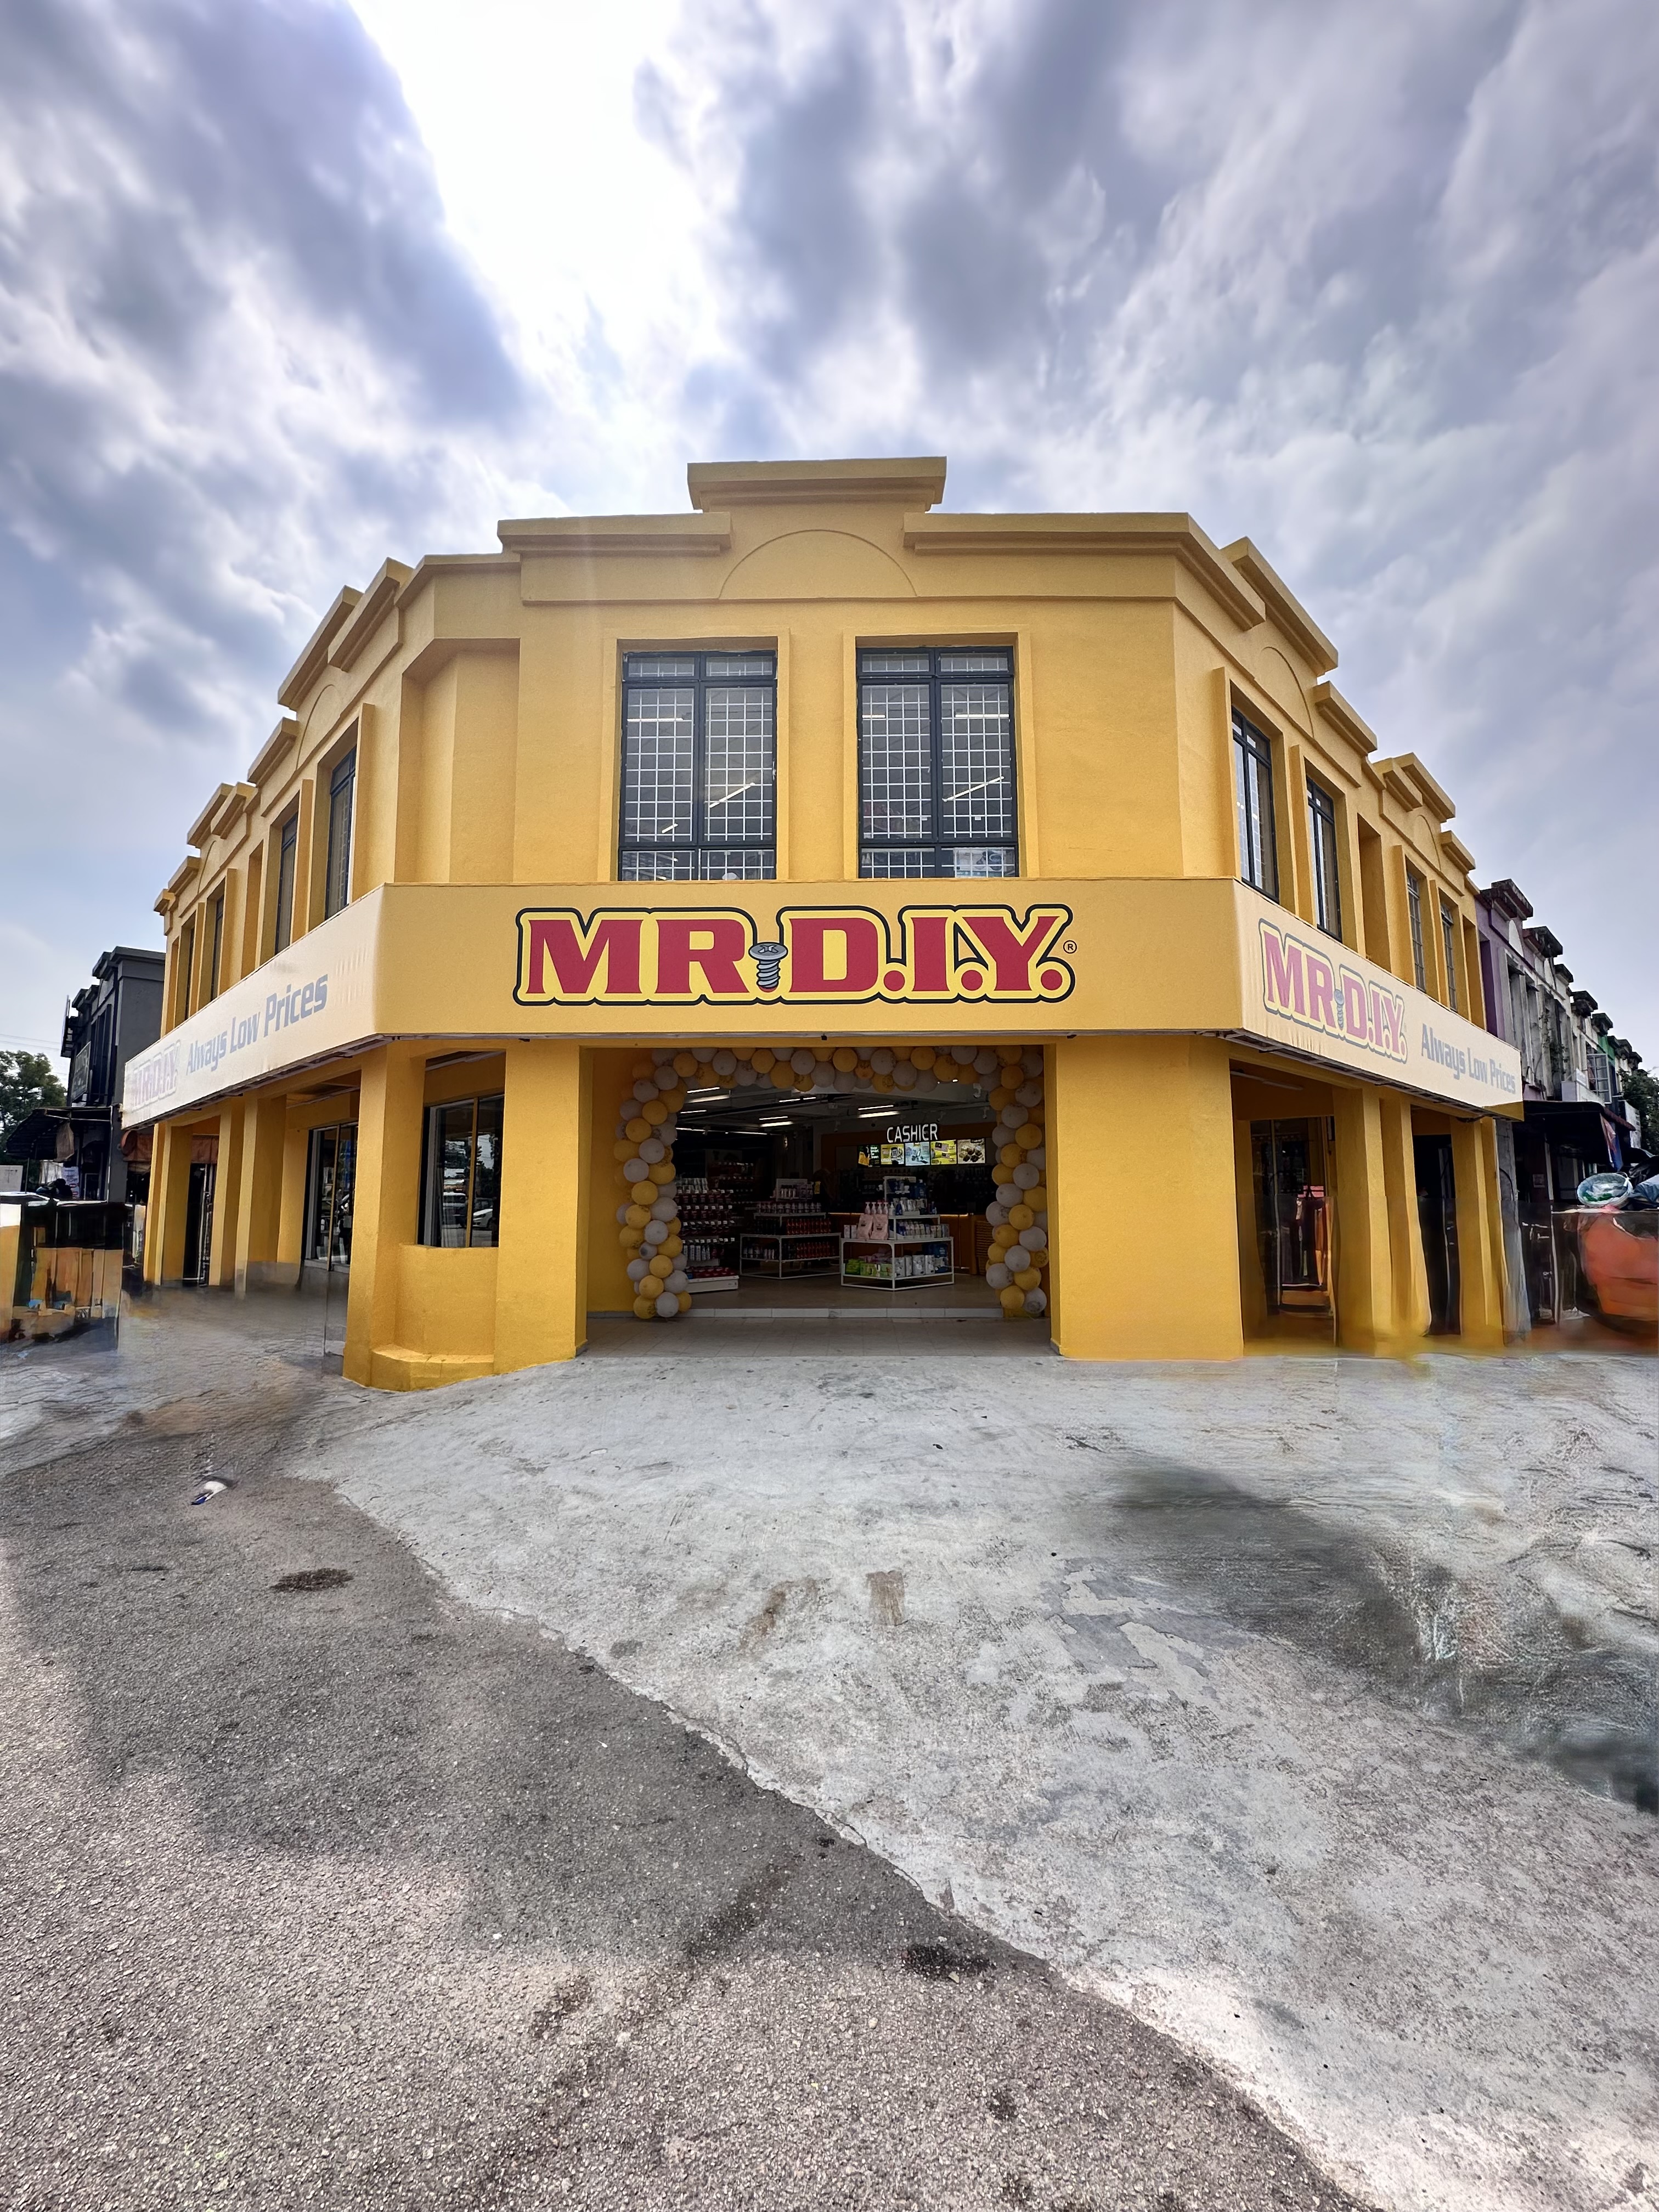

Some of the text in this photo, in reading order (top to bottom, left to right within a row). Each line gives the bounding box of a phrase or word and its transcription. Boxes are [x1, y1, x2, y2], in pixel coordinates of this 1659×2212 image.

[187, 974, 328, 1075] Always Low Prices
[1421, 1023, 1516, 1094] Always Low Prices
[887, 1124, 938, 1143] CASHIER
